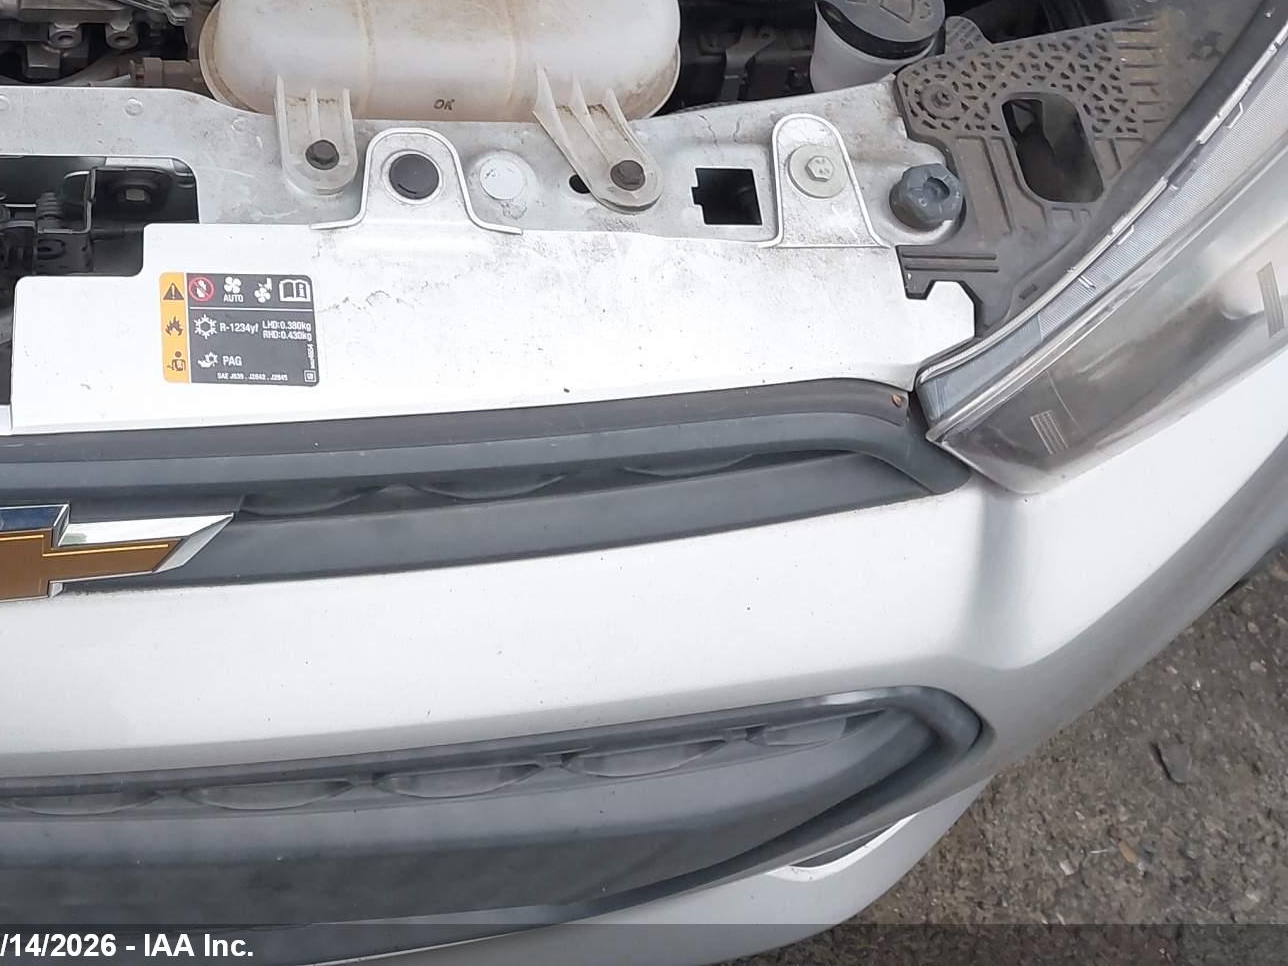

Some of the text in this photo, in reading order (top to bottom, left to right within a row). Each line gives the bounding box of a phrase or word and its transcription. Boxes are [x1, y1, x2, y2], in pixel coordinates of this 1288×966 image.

[223, 294, 244, 303] AUTO
[219, 321, 259, 334] R-1234yf
[222, 355, 243, 367] PAG
